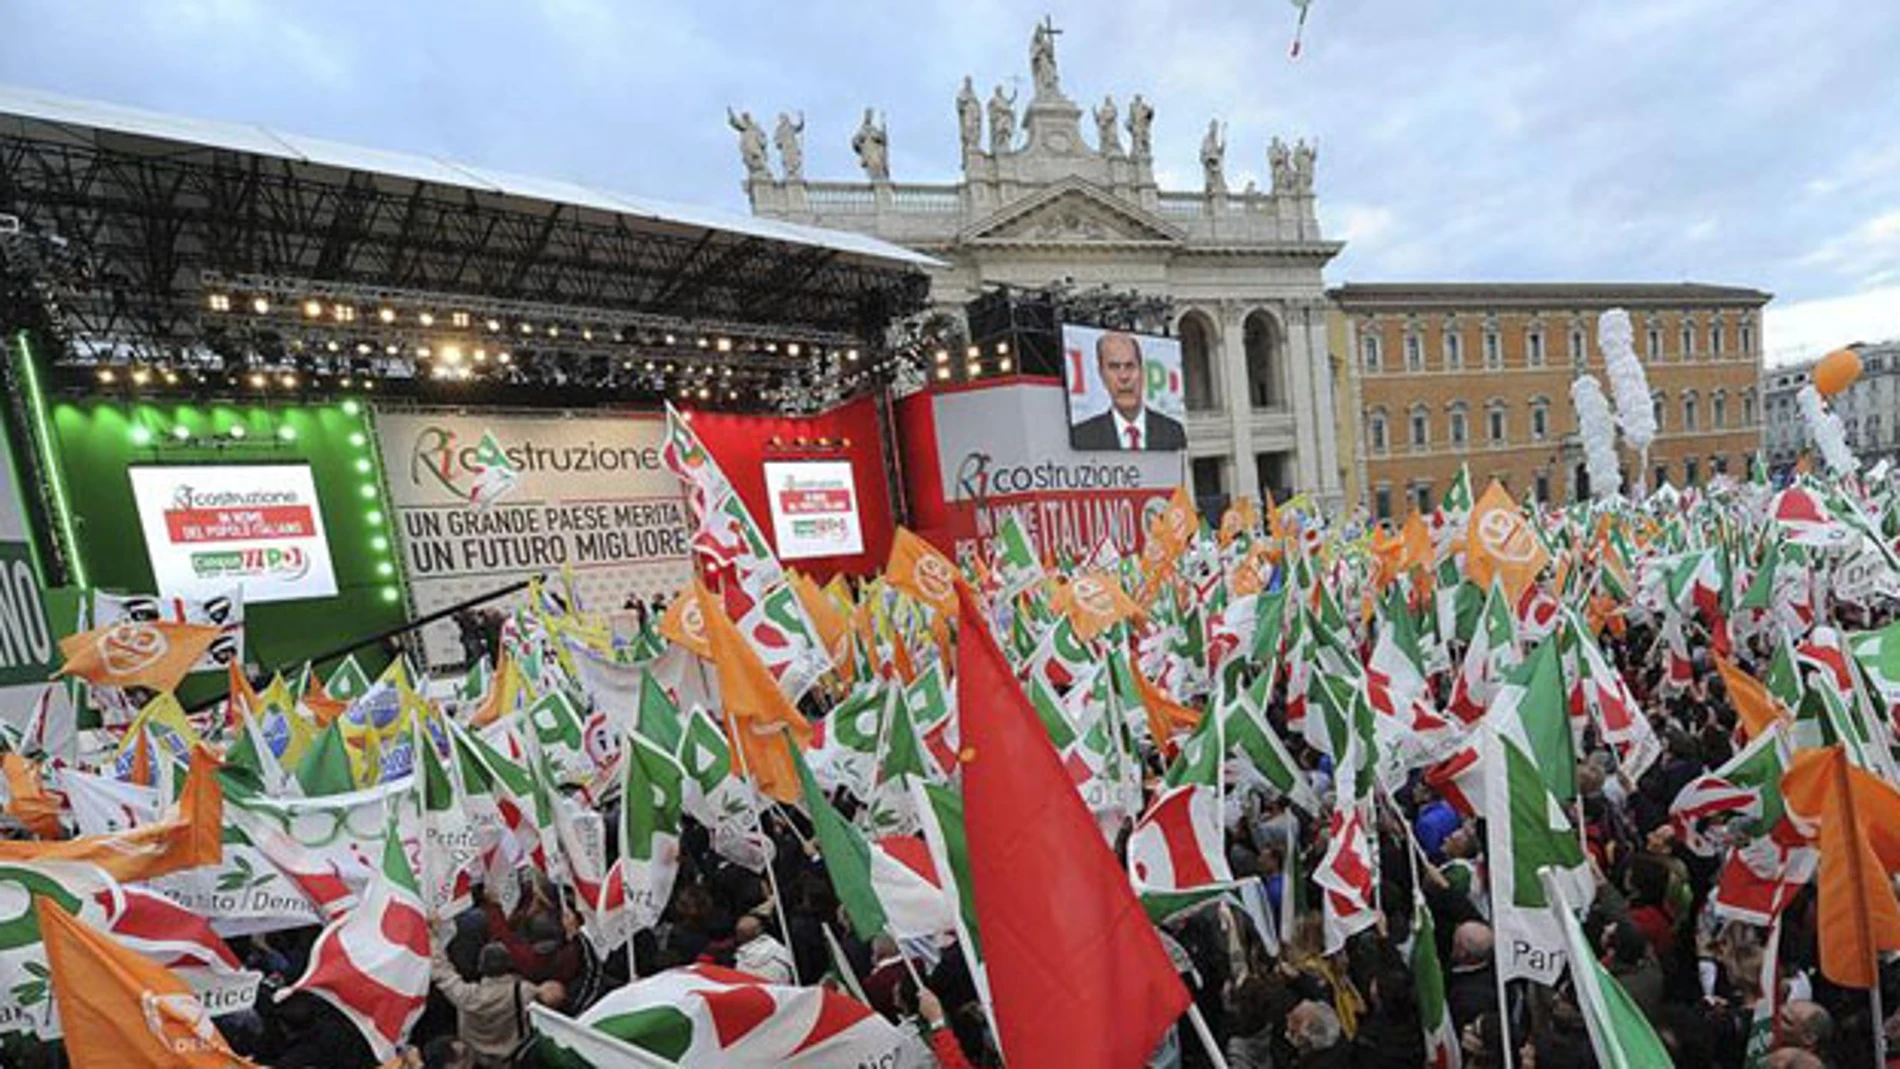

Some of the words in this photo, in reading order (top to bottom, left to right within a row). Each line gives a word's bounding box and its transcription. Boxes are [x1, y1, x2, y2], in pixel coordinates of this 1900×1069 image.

[411, 426, 662, 501] Ricstruzione
[405, 510, 443, 538] UN
[450, 506, 540, 536] GRANDE
[548, 504, 609, 532] PAESE
[614, 503, 683, 529] MERITA
[410, 540, 455, 573] UN
[464, 534, 568, 569] FUTURO
[576, 528, 688, 560] MIGLIORE
